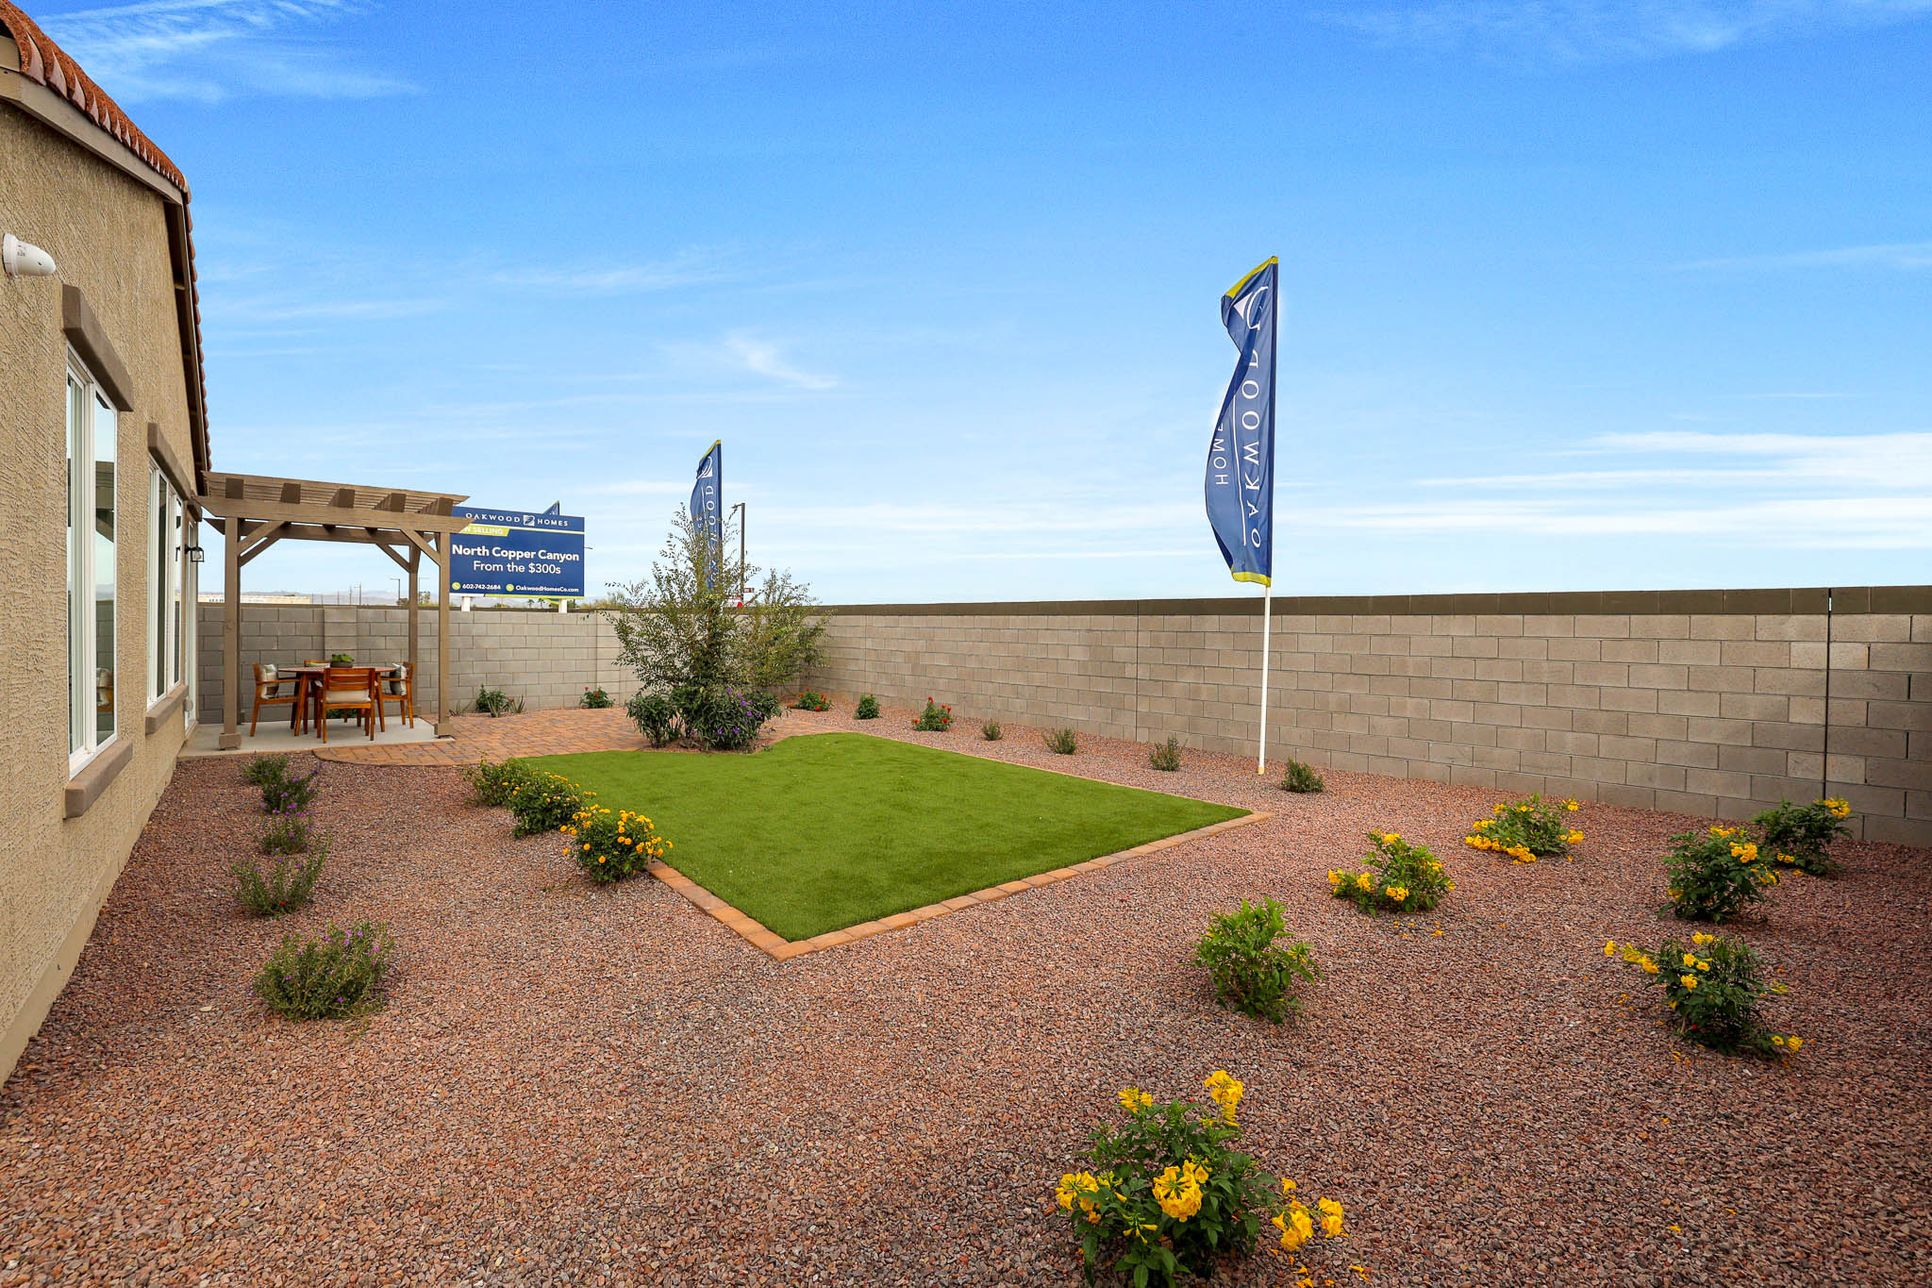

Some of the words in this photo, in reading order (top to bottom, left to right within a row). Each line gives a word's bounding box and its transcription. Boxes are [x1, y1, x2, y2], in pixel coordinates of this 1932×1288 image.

[465, 512, 521, 523] OAKWOOD
[537, 518, 568, 527] HOMES
[452, 544, 490, 557] North
[492, 547, 536, 560] Copper
[538, 550, 580, 563] Canyon
[473, 560, 504, 572] From
[507, 562, 525, 573] the
[528, 562, 561, 574] $300s
[515, 584, 580, 593] OakwoodHomesCo.com
